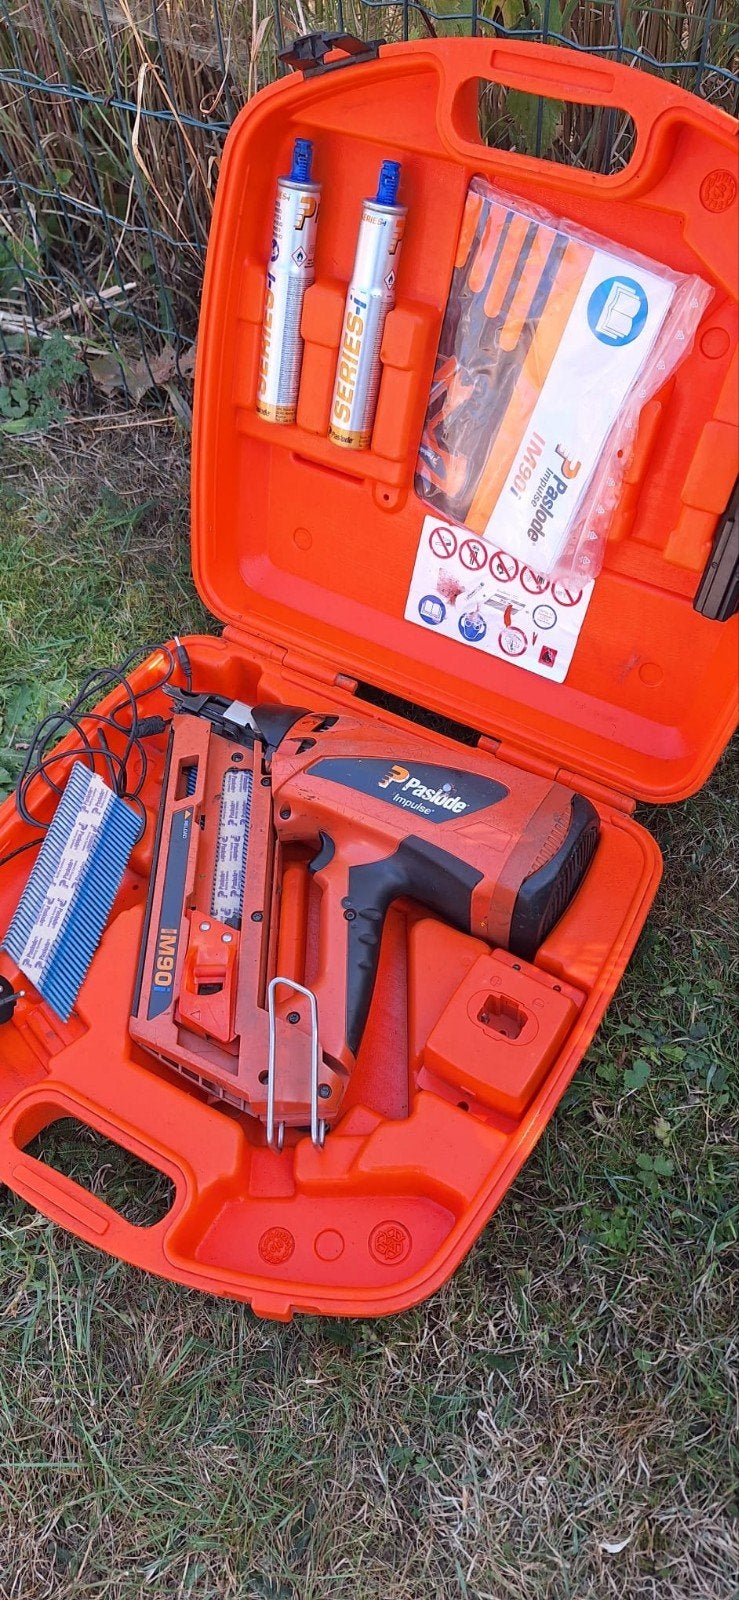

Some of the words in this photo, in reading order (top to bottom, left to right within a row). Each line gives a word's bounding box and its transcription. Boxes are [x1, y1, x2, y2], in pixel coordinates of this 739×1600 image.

[333, 291, 367, 424] SERIES-i
[510, 431, 546, 500] IM90i
[530, 467, 554, 508] Impulse
[526, 474, 568, 543] Paslode
[392, 793, 435, 815] Impulse
[401, 777, 467, 814] Paslode
[153, 927, 178, 993] IM90i
